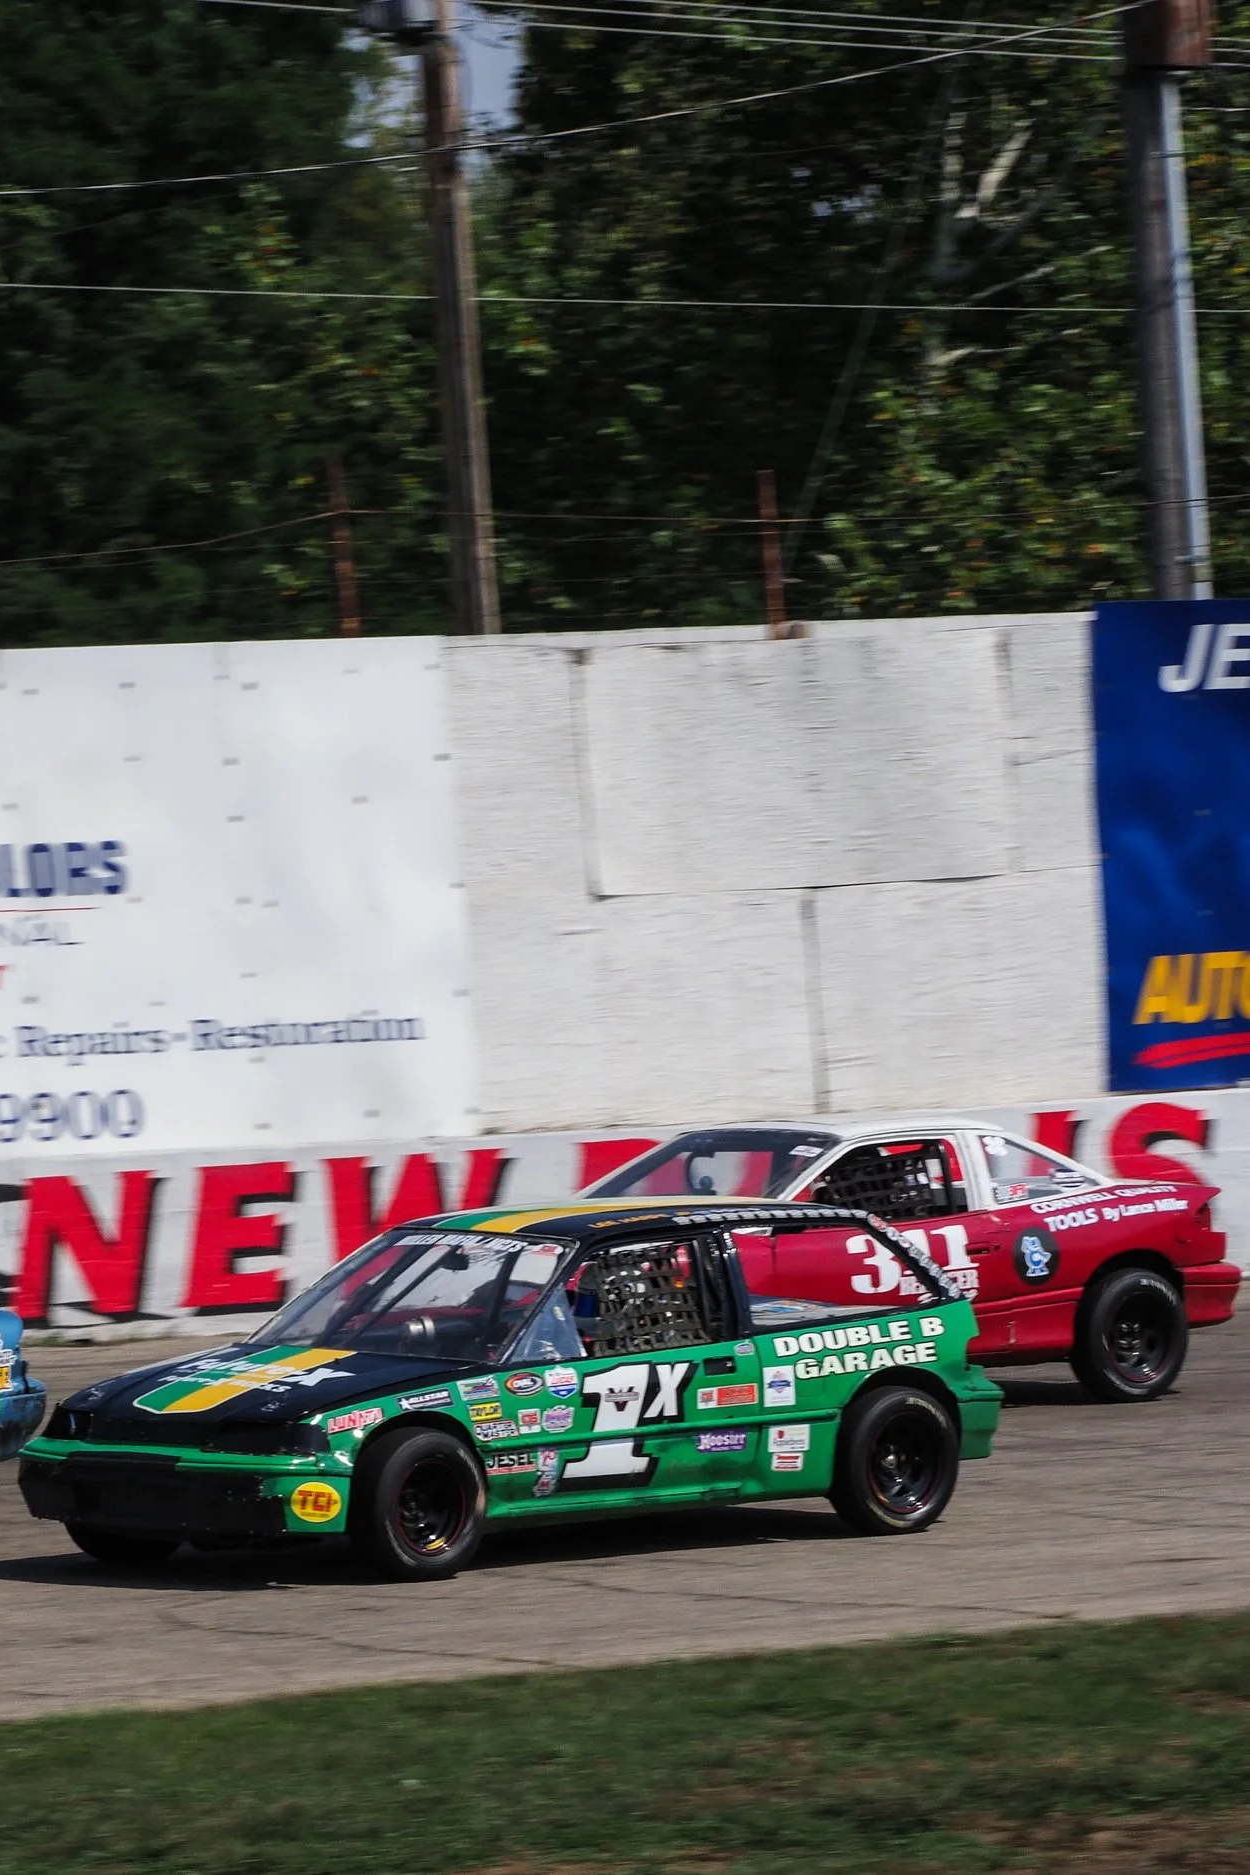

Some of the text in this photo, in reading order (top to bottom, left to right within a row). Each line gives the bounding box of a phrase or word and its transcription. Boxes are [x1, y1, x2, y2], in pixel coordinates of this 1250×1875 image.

[1030, 1190, 1118, 1214] CORNWELL
[1044, 1208, 1099, 1232] TOOLS
[773, 1317, 945, 1357] DOUBLE B
[794, 1341, 938, 1381] GARAGE
[486, 1452, 534, 1468] JESEL
